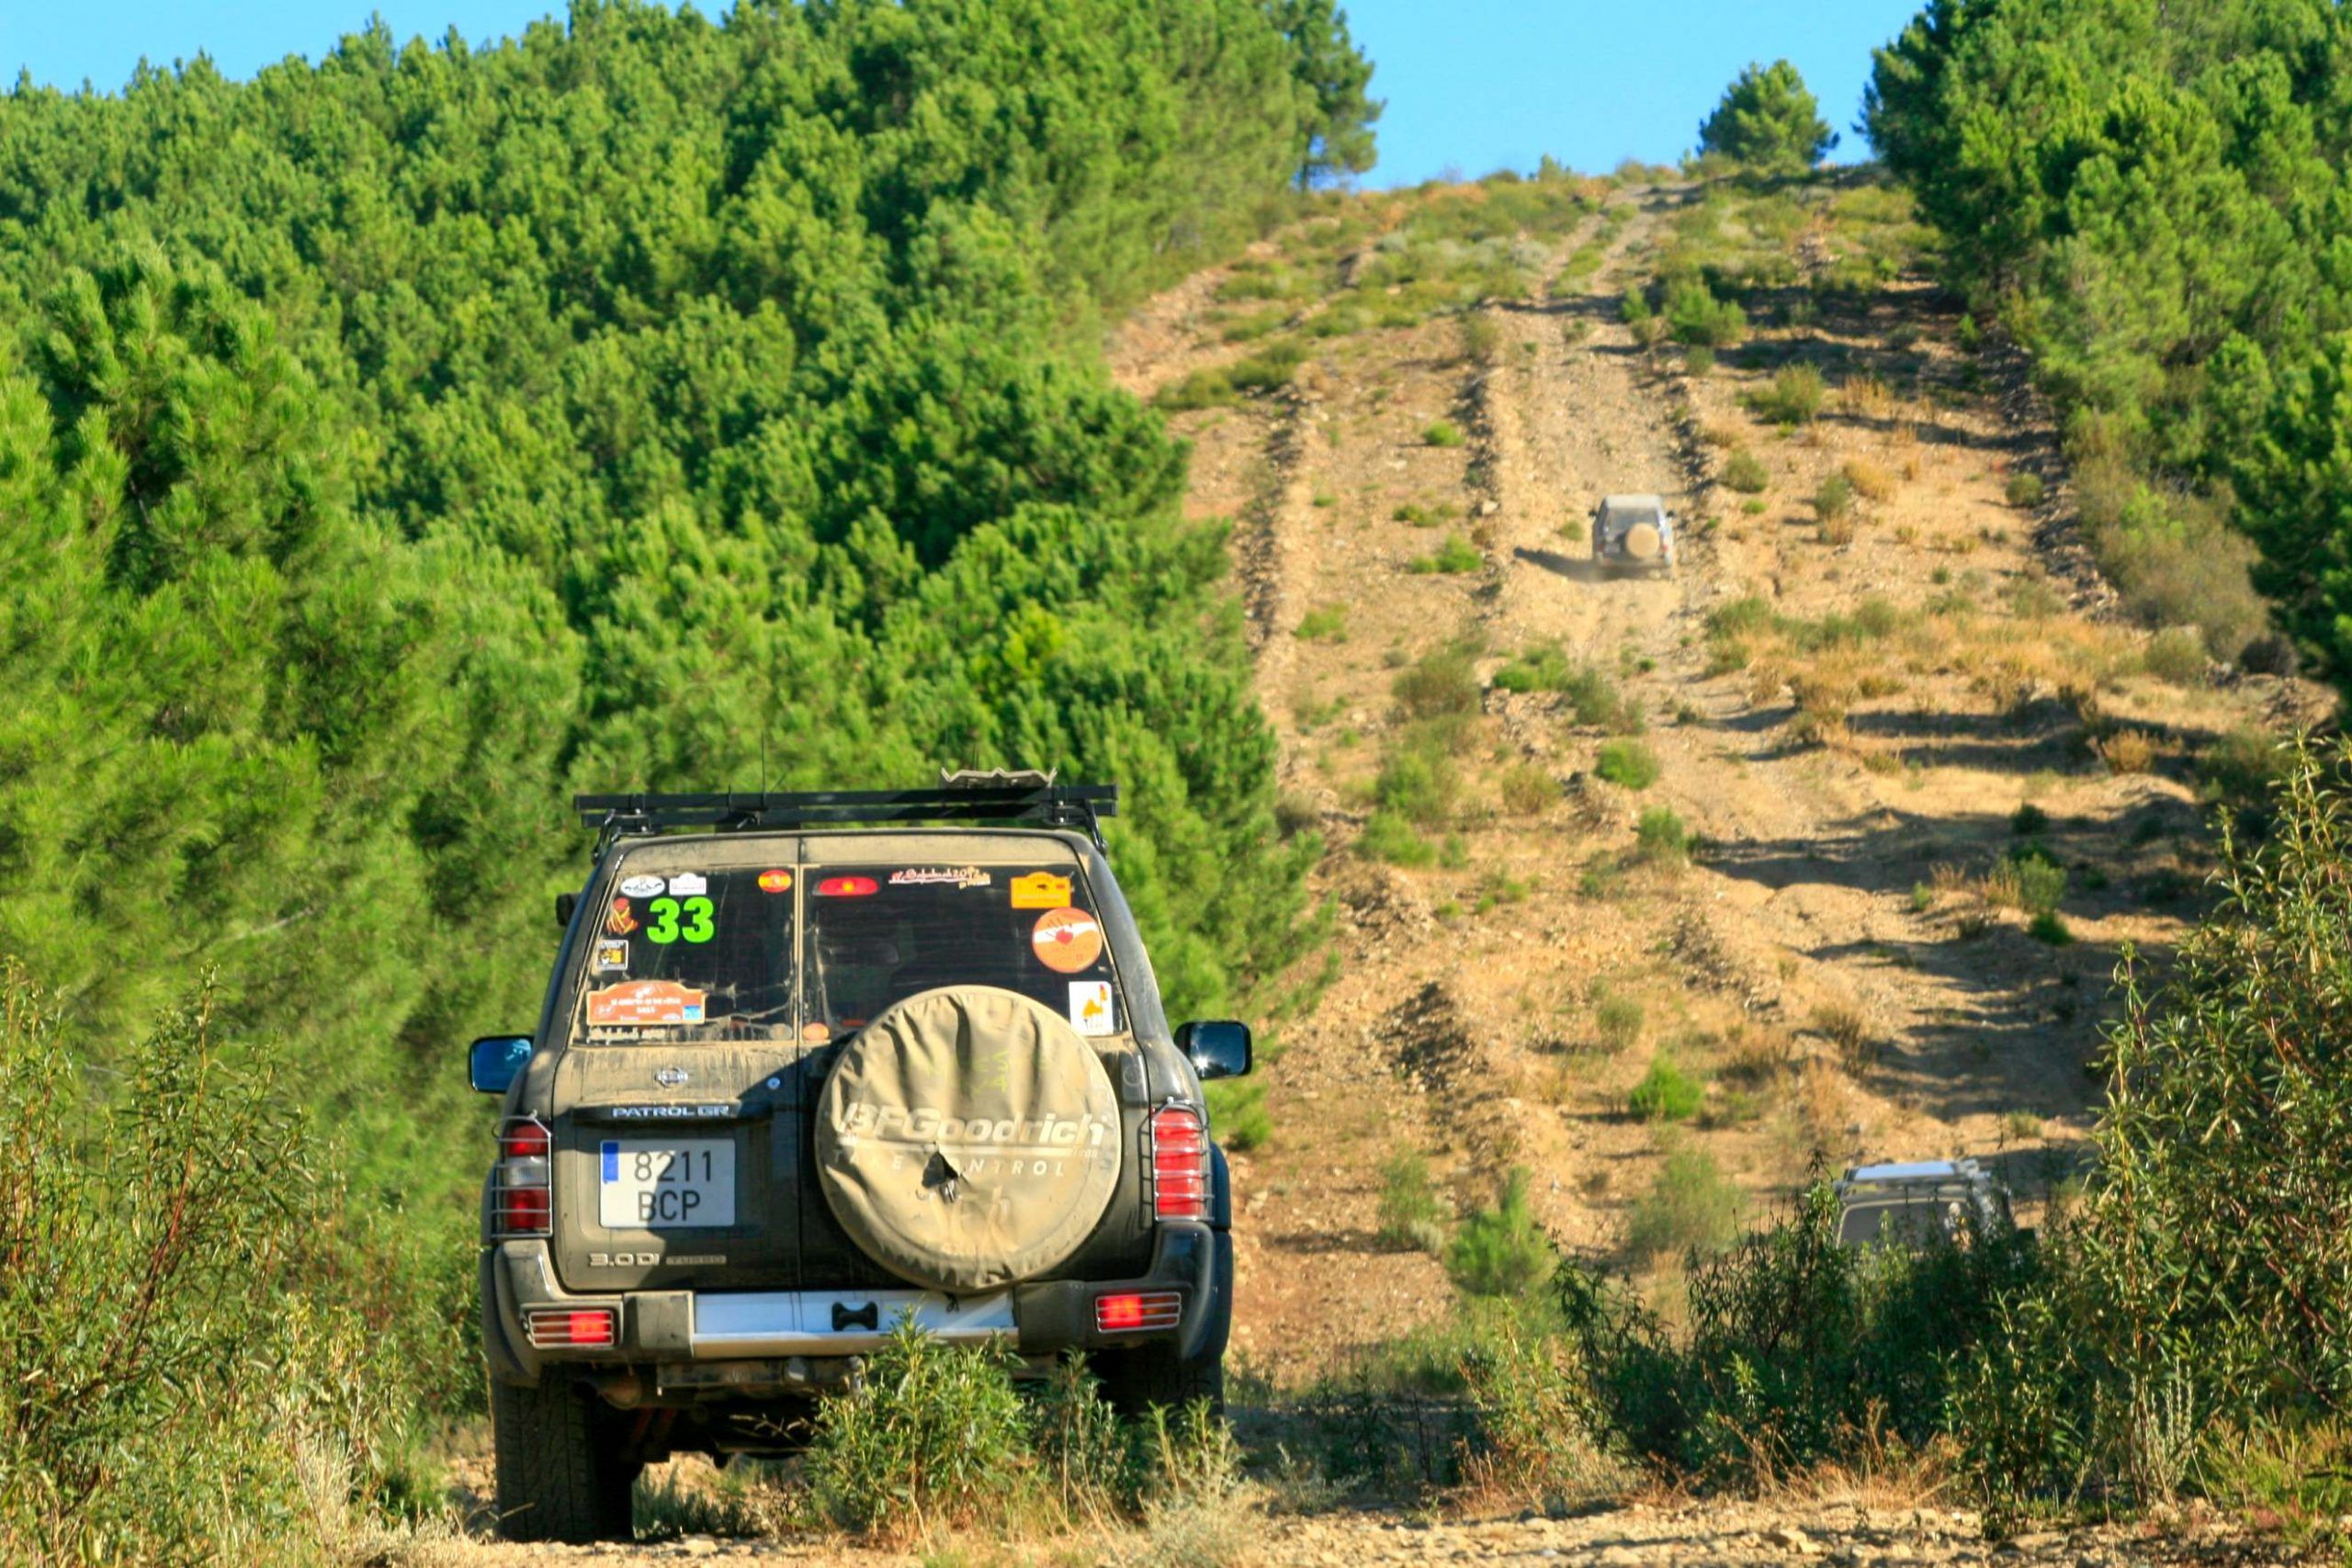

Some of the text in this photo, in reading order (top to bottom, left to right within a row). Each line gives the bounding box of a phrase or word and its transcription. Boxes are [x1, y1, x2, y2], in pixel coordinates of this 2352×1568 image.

[647, 897, 714, 944] 33
[613, 1105, 729, 1118] PATROL GR
[838, 1102, 1104, 1145] BFGoodrich
[634, 1150, 712, 1182] 8211
[937, 1155, 1064, 1177] ONTROL
[638, 1190, 701, 1222] BCP
